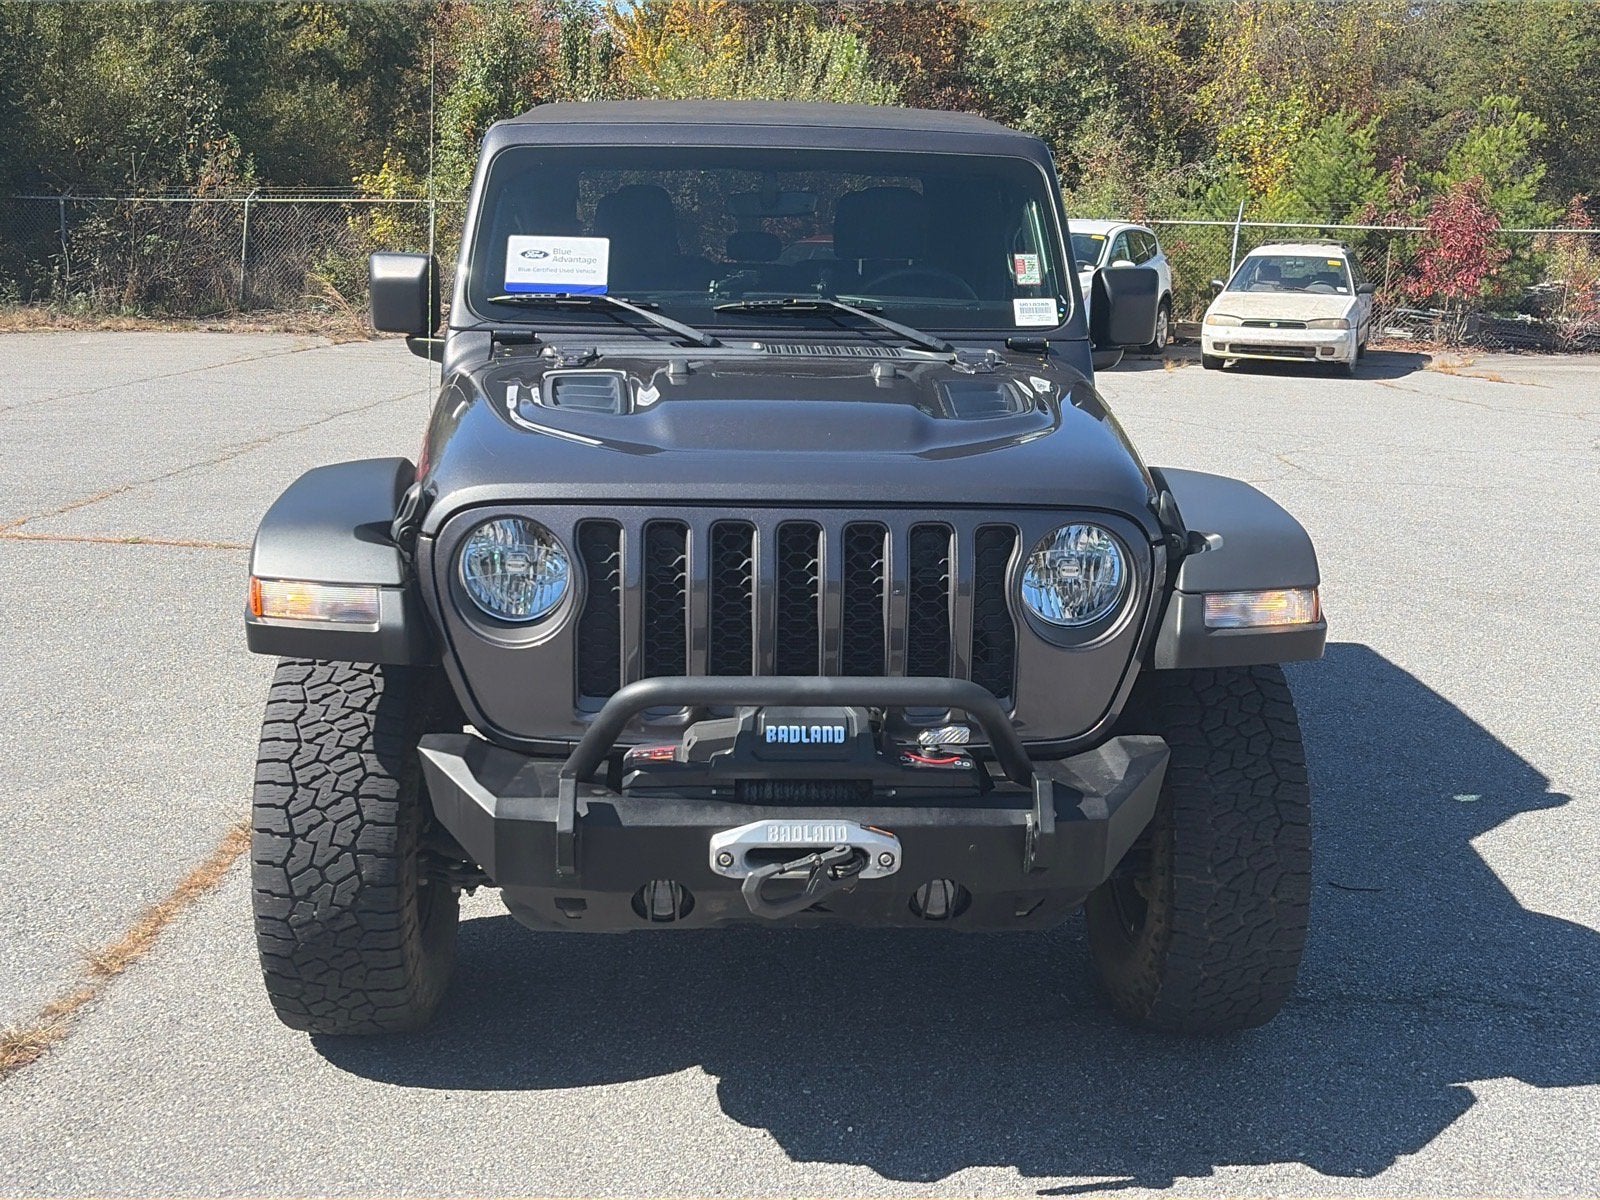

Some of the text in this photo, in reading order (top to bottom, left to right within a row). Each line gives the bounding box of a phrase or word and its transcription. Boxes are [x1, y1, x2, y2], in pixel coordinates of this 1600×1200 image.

[522, 249, 547, 259] Ford
[552, 255, 597, 264] Advantage
[766, 725, 845, 743] BADLAND
[767, 824, 847, 842] BADLAND
